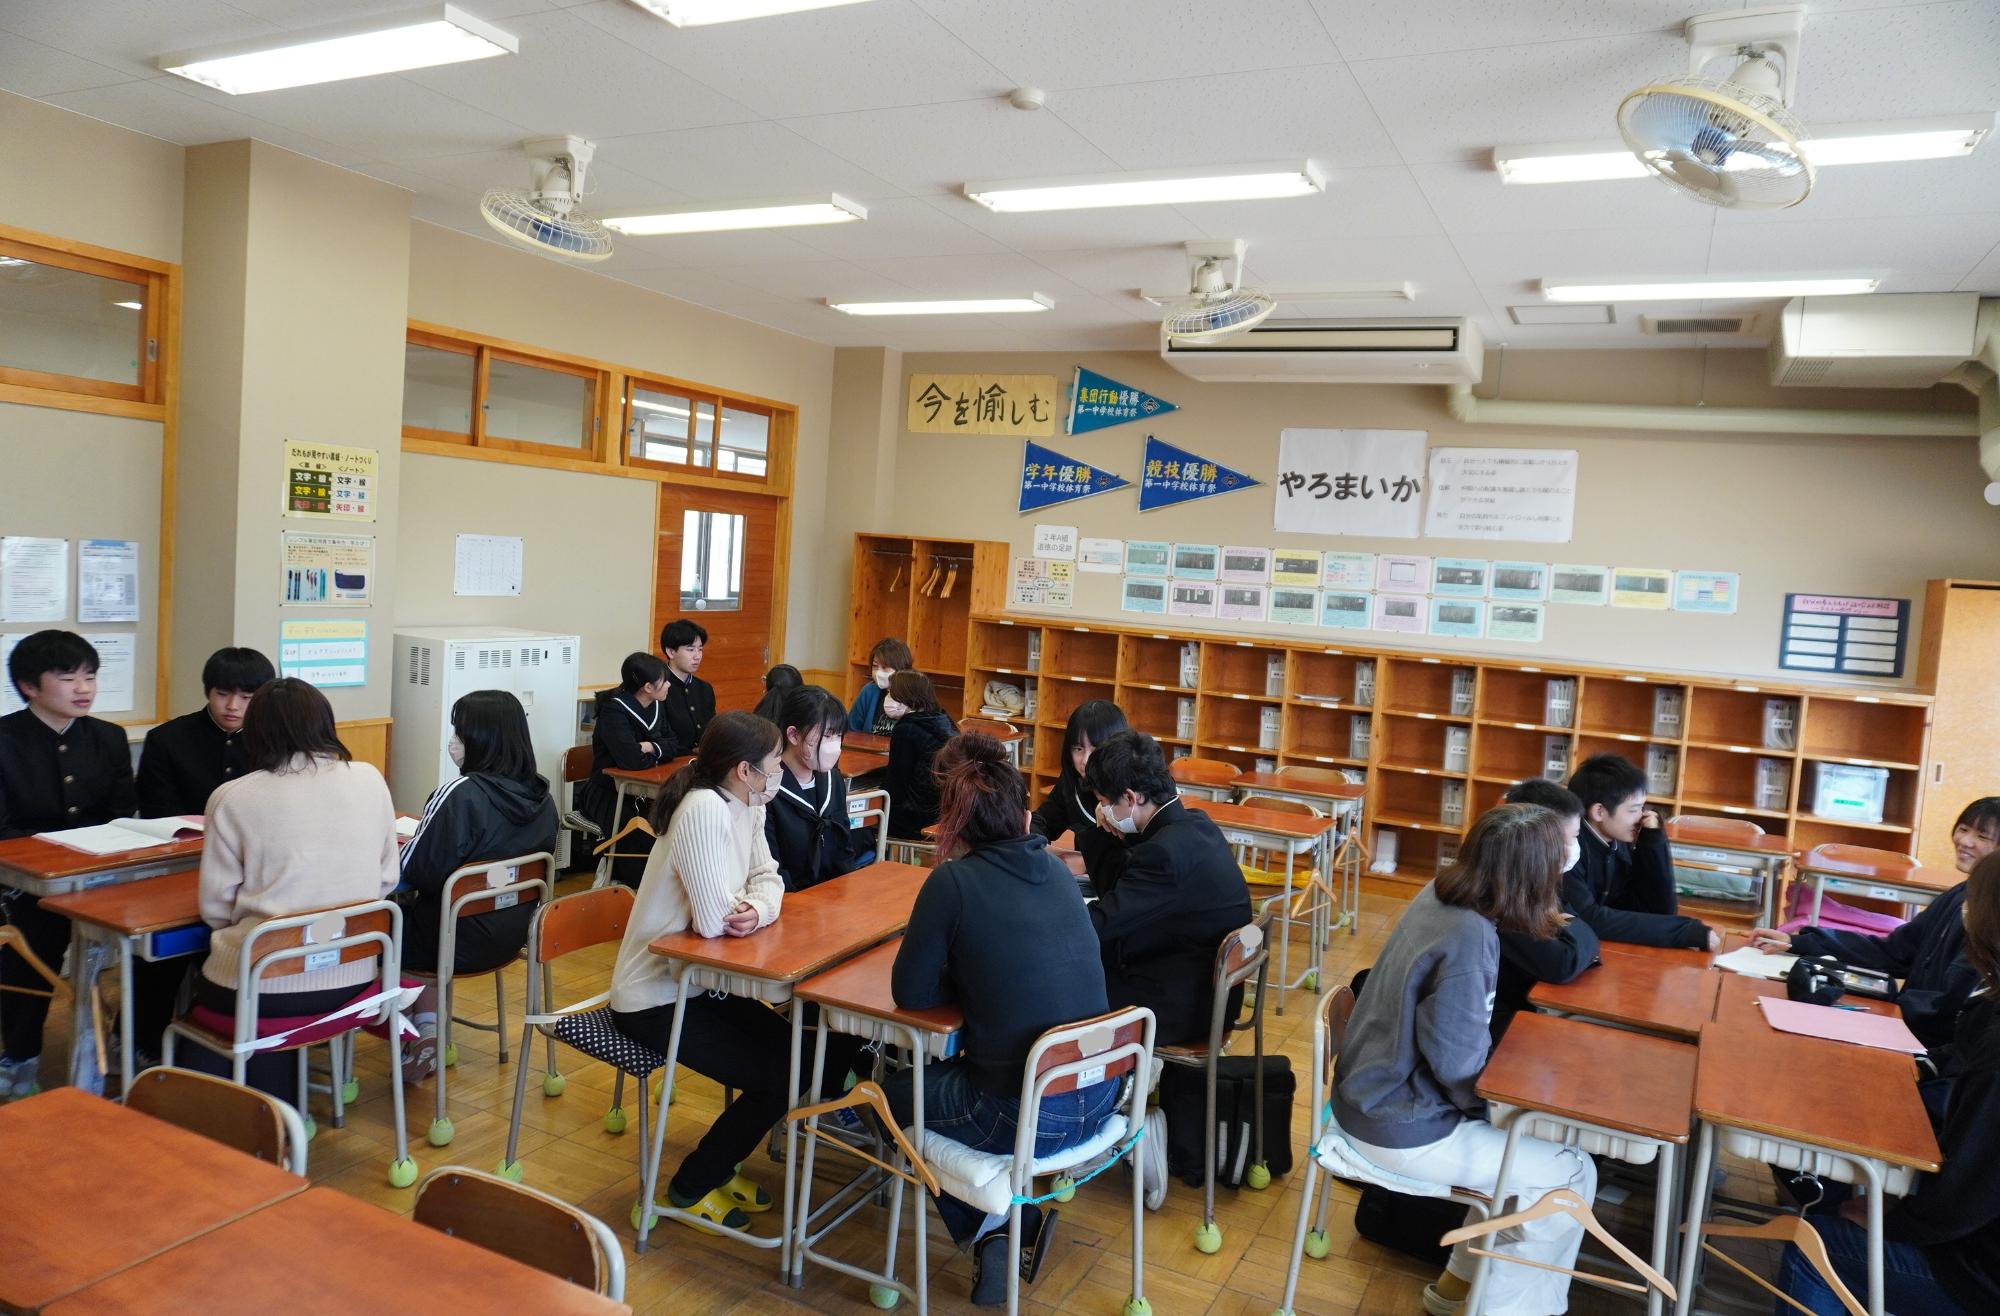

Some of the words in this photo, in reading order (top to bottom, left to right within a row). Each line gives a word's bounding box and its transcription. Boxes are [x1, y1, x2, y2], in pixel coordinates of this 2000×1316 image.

[916, 382, 1049, 426] 今を愉しむ
[1080, 386, 1140, 406] 集団行動優勝
[1077, 404, 1138, 417] 第一中学校体育祭
[1025, 463, 1092, 483] 学年優勝
[1146, 459, 1217, 482] 競技優勝
[1024, 480, 1092, 494] 第一中学校体育祭
[1144, 478, 1217, 493] 第一中学校体育祭
[1280, 471, 1421, 502] やろまいか
[1037, 543, 1073, 552] 道徳の足跡
